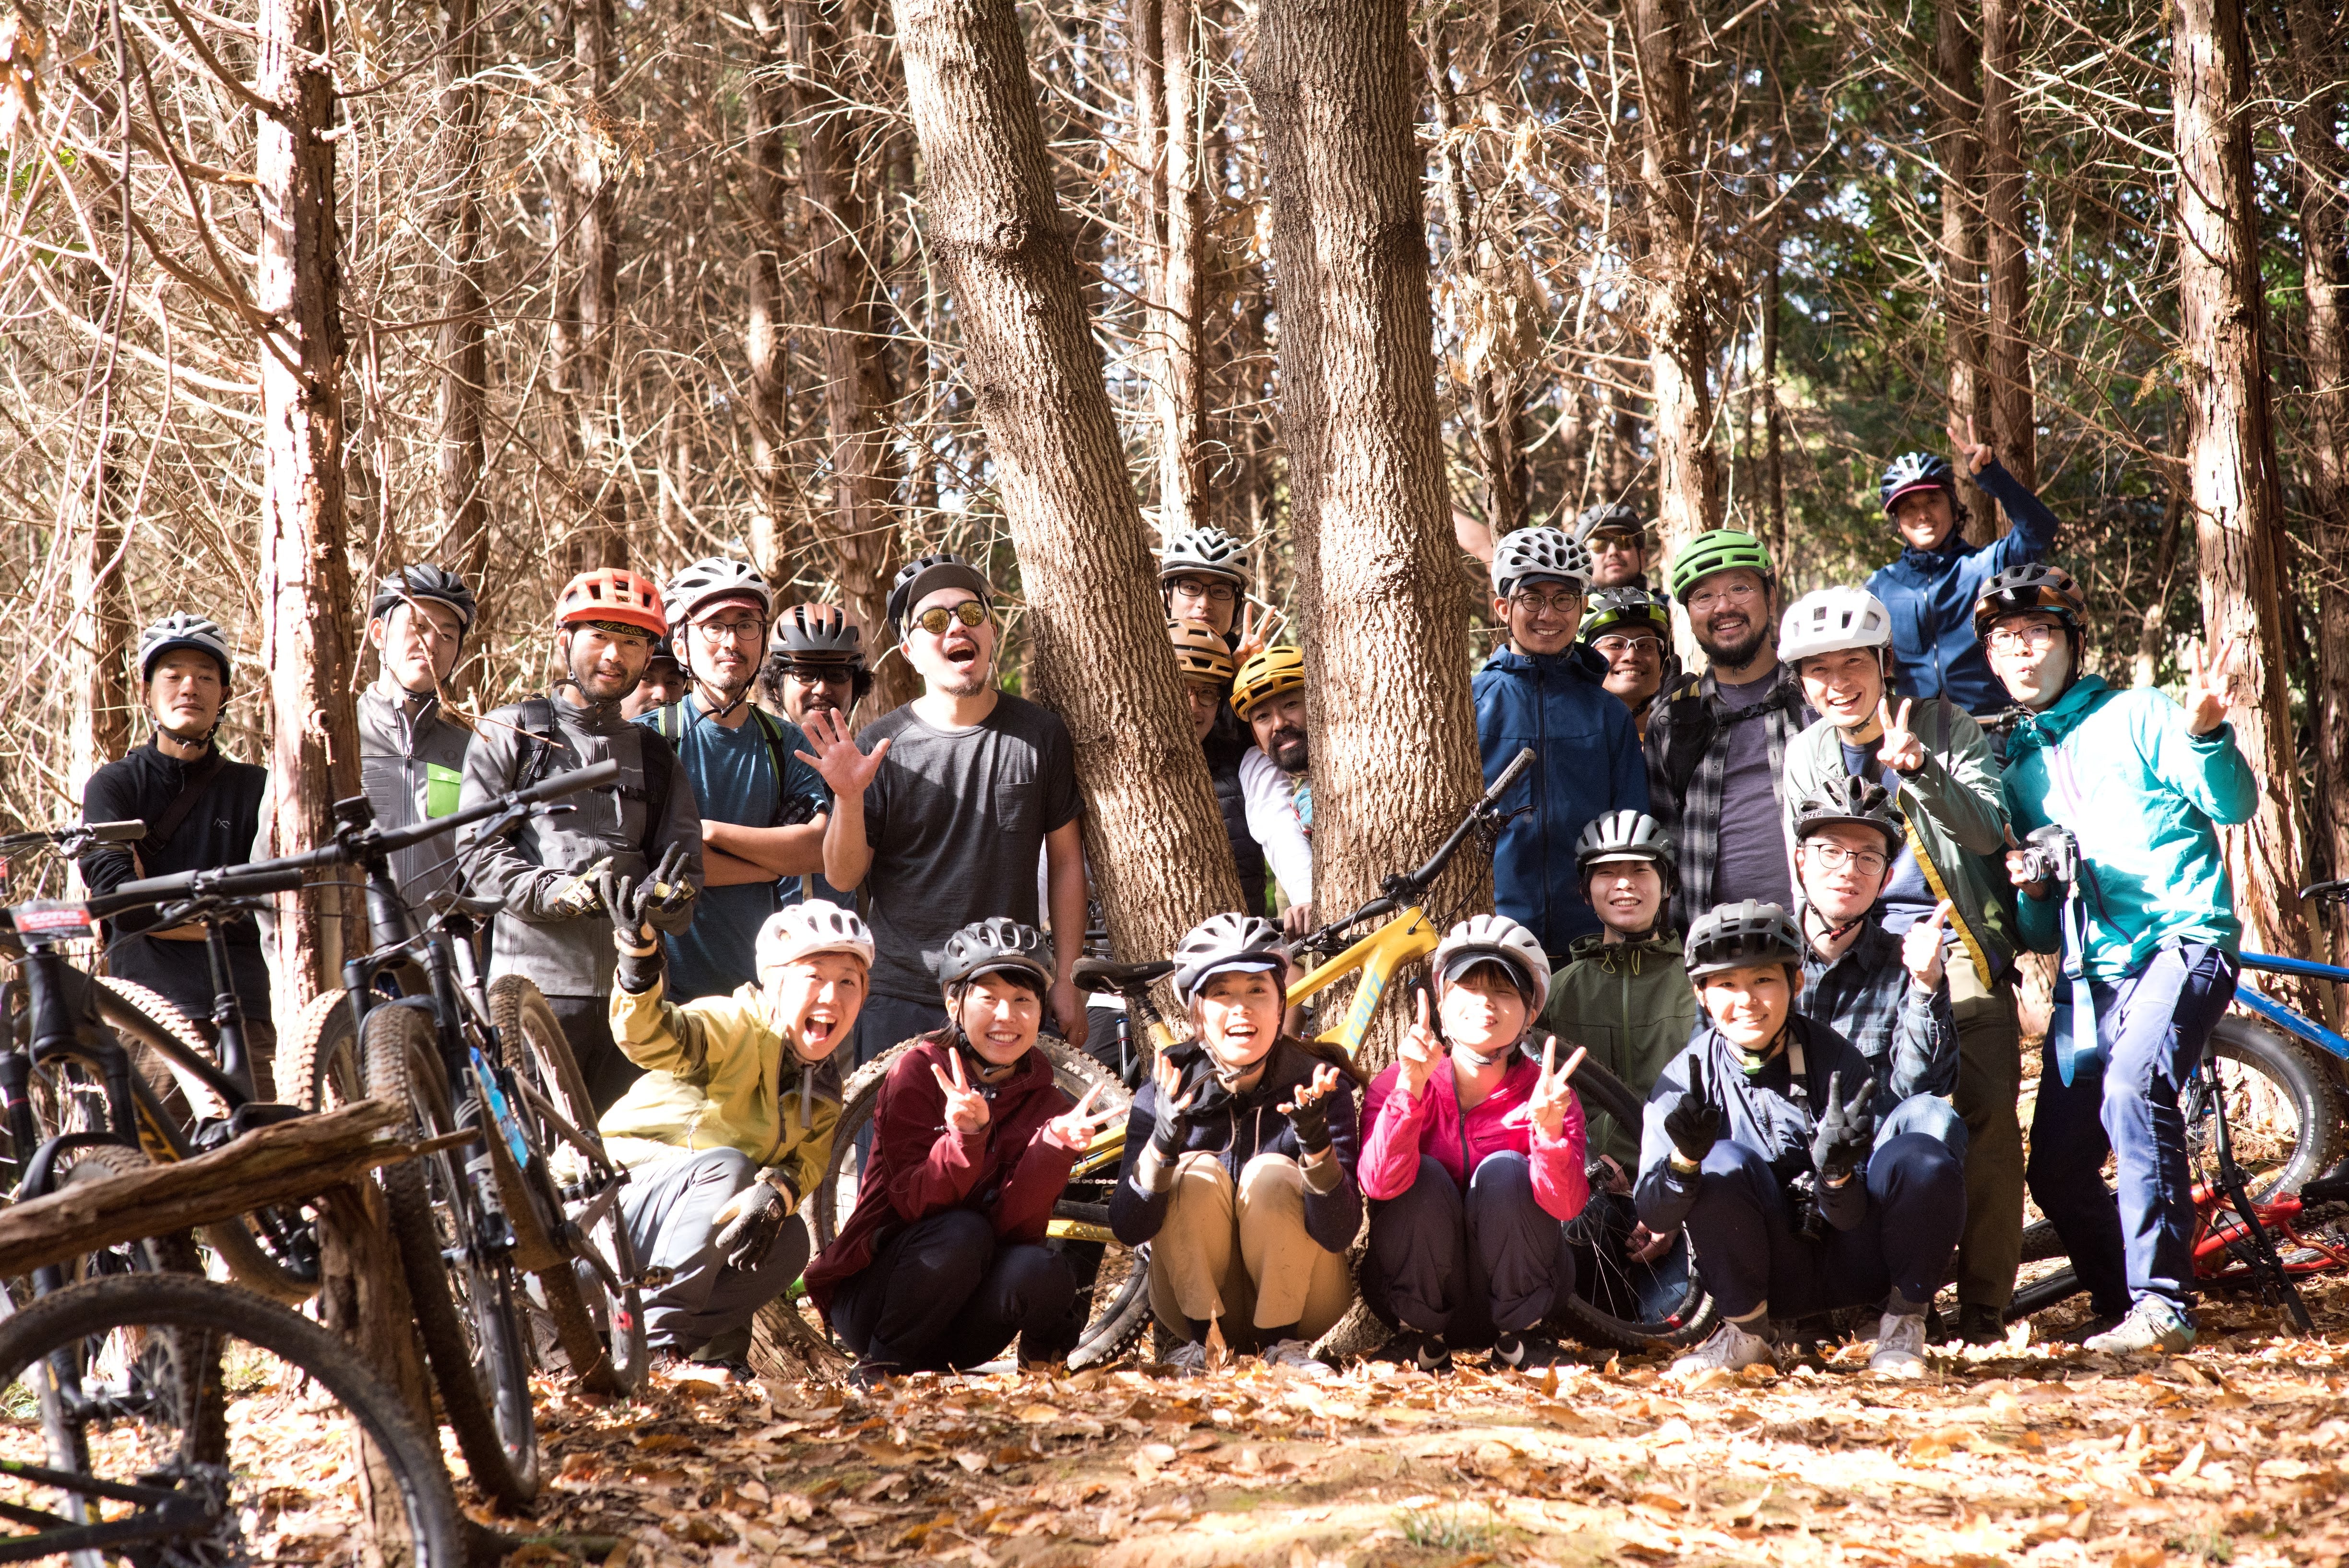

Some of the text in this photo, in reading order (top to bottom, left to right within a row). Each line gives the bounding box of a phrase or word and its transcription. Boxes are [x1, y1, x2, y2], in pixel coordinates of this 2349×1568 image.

[1799, 809, 1823, 824] LAZER
[998, 948, 1025, 956] catlike
[1349, 971, 1387, 1046] CRUZ
